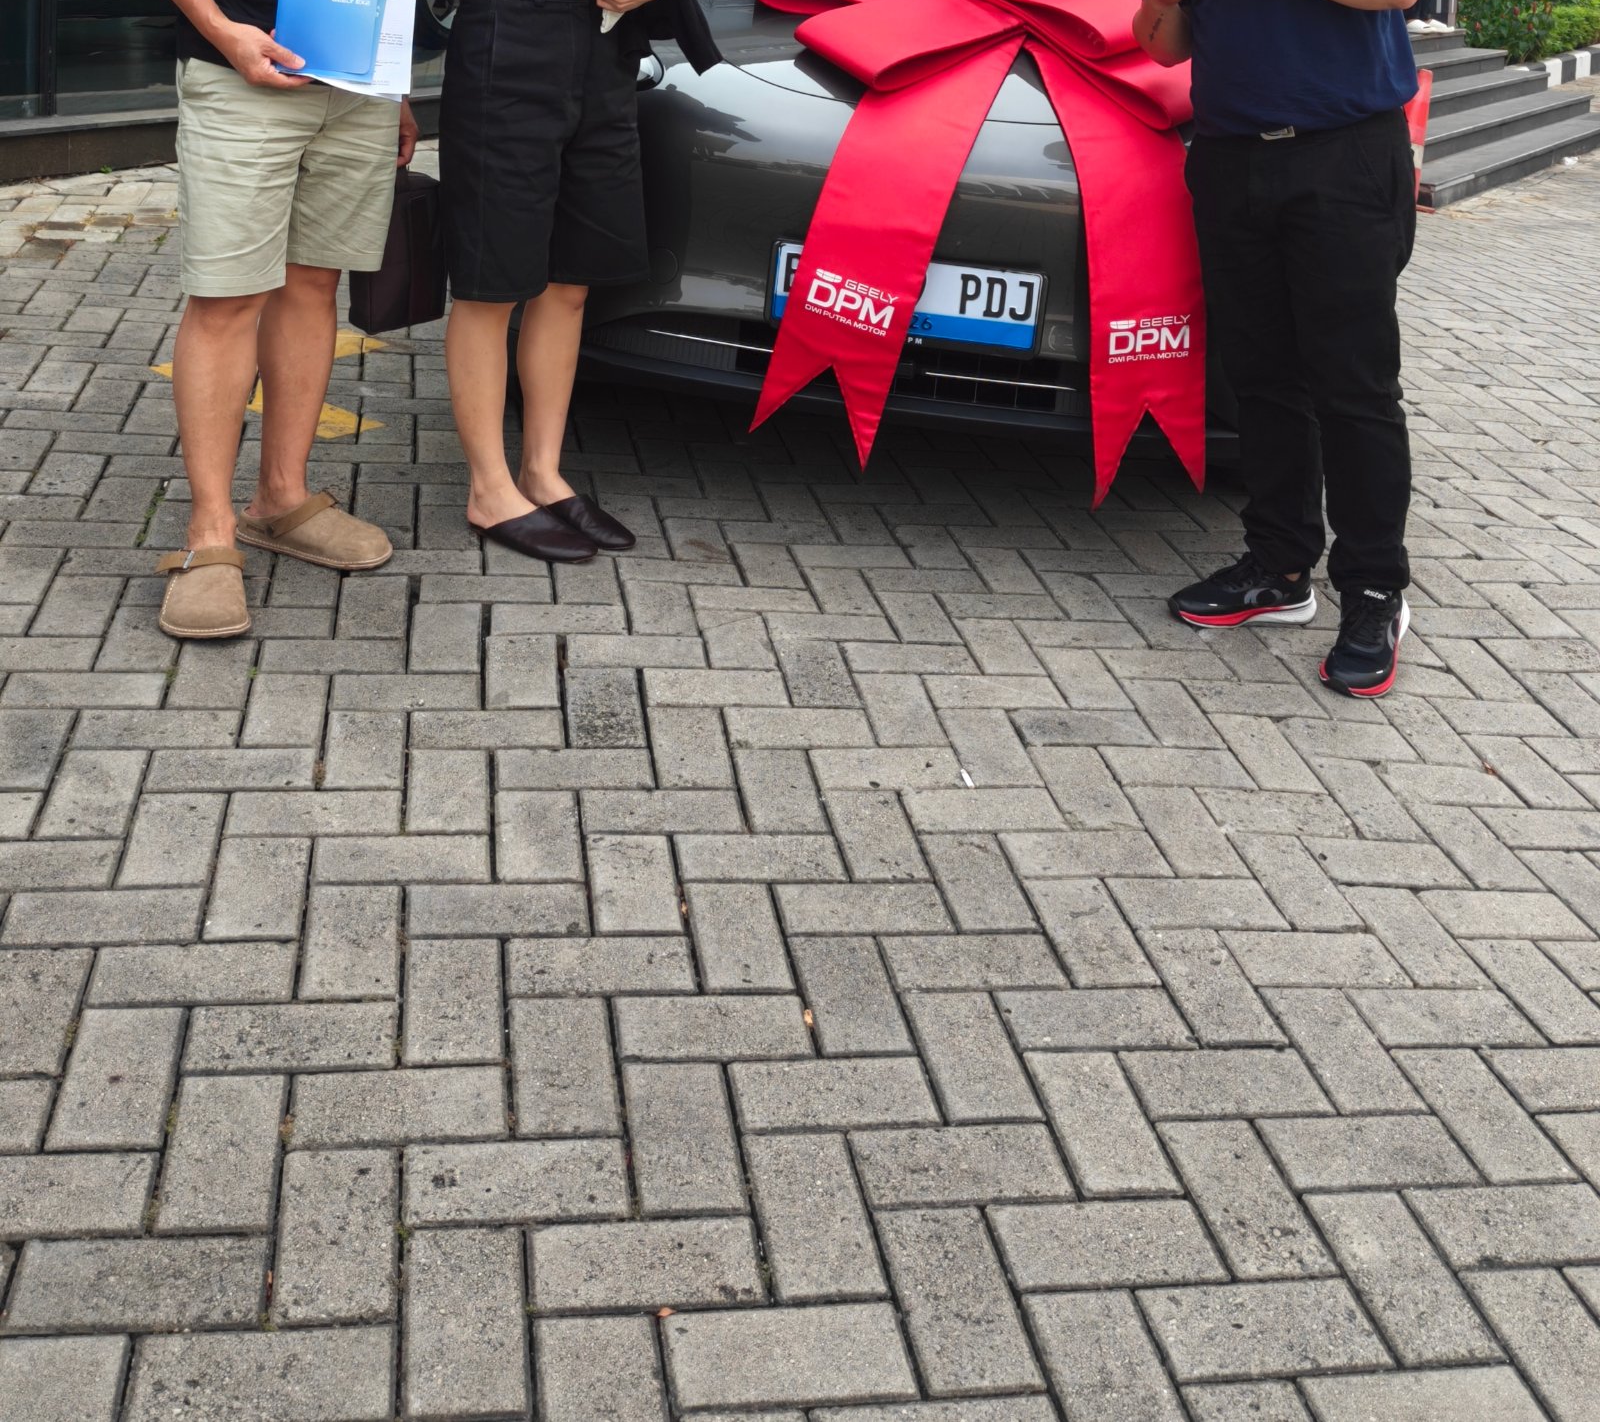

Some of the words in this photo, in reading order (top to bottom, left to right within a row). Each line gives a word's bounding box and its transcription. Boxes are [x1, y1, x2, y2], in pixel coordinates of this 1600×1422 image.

[806, 278, 895, 329] DPM
[844, 279, 899, 305] GEELY
[959, 273, 1035, 322] PDJ
[804, 303, 822, 315] DWI
[823, 311, 852, 326] PUTRA
[853, 321, 887, 337] MOTOR
[1140, 313, 1191, 329] GEELY
[1109, 325, 1190, 356] DPM
[1108, 356, 1125, 364] DWI
[1126, 353, 1156, 363] PUTRA
[1157, 351, 1189, 360] MOTOR
